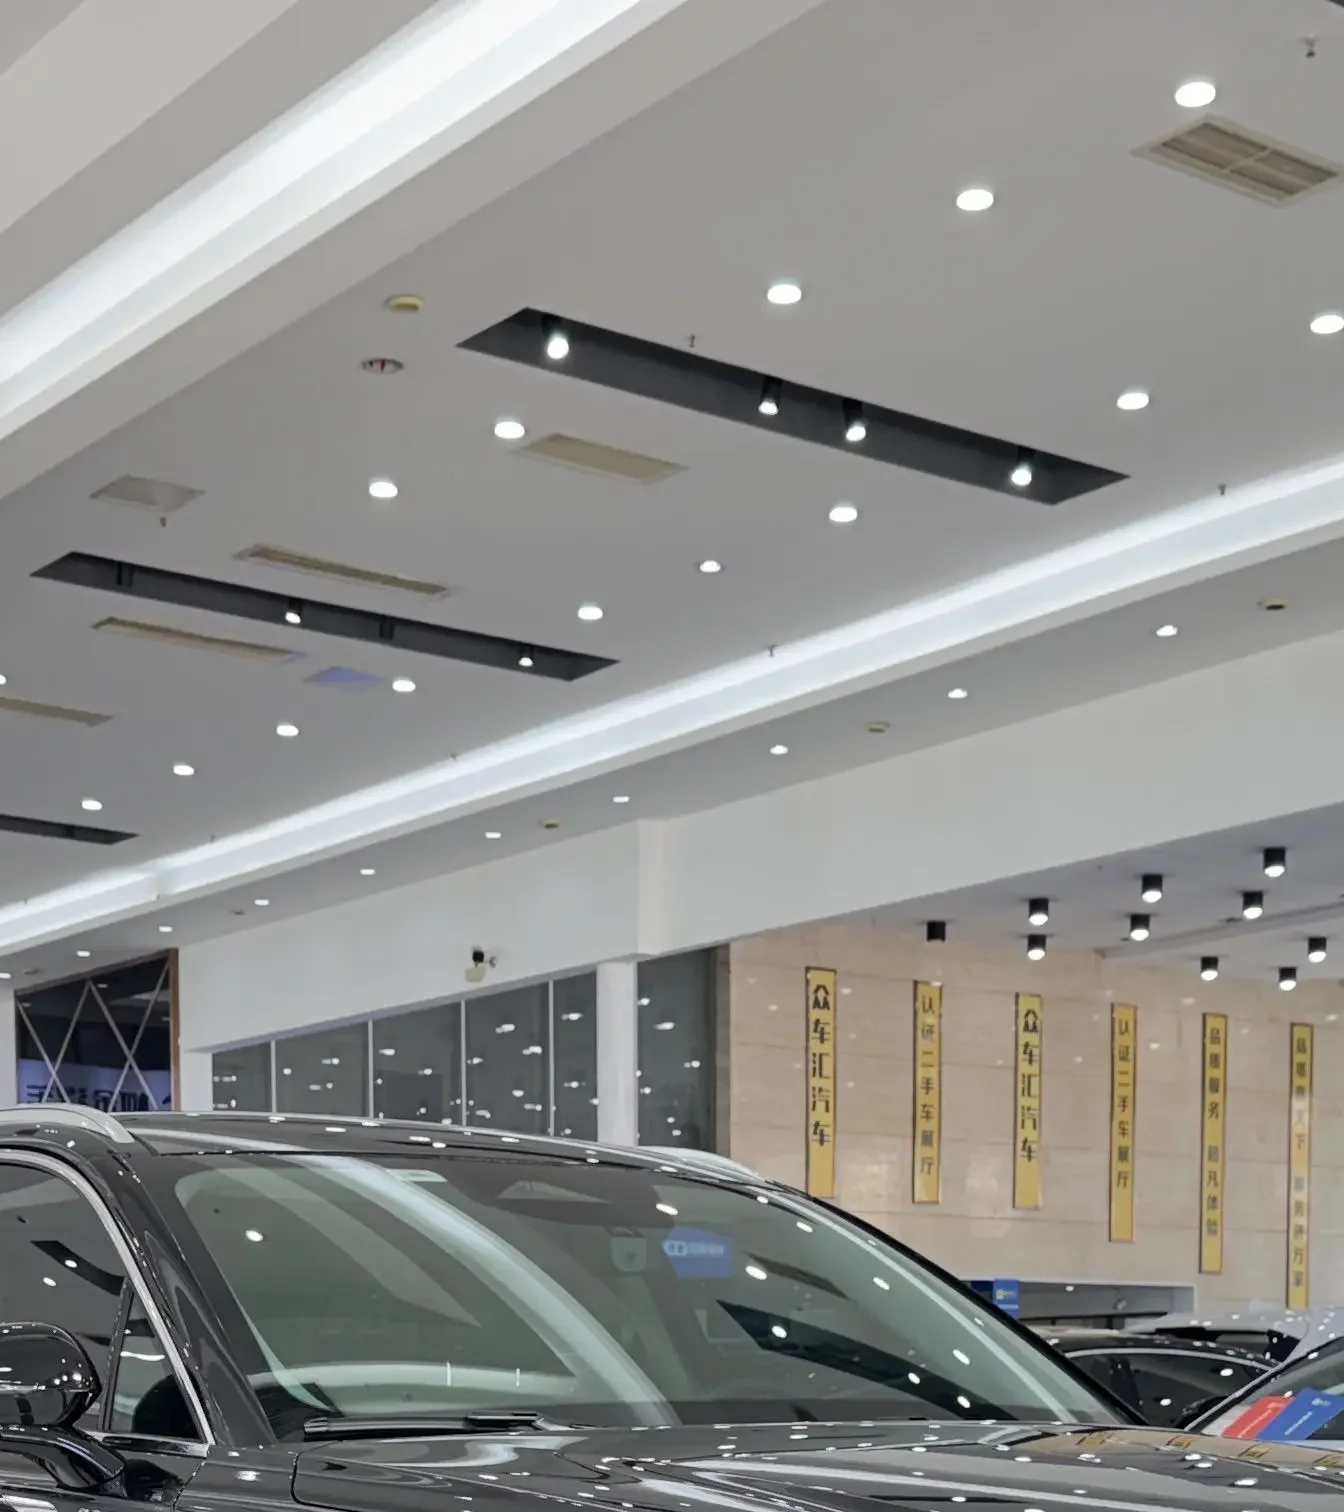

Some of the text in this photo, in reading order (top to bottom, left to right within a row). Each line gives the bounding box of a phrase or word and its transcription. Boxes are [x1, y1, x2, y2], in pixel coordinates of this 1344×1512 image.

[811, 983, 831, 1147] 众车汇汽车
[920, 995, 936, 1176] 认证二手车展厅
[1020, 1008, 1040, 1163] 众车汇汽车
[1115, 1018, 1131, 1190] 认证二手车展厅
[1207, 1027, 1221, 1120] 品质服务
